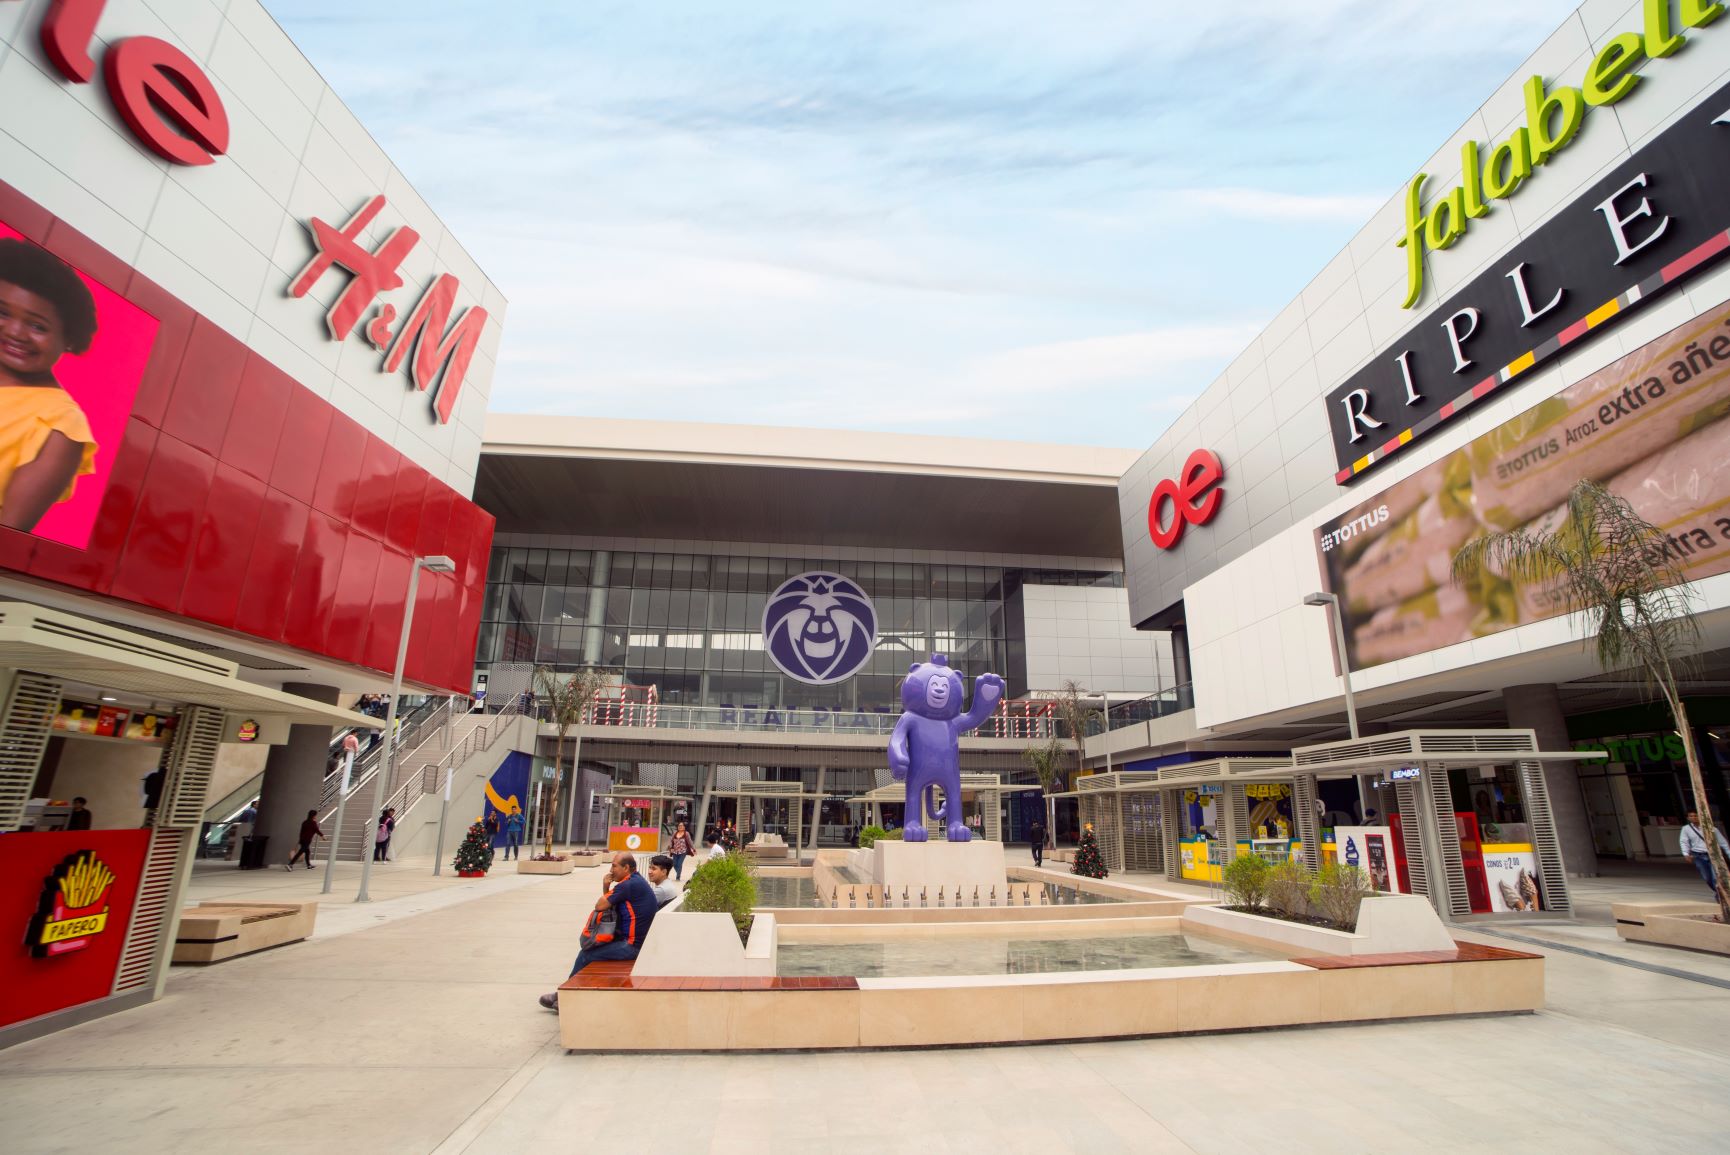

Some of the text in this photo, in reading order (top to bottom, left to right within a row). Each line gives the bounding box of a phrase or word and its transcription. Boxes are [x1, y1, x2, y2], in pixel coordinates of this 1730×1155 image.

[287, 194, 488, 427] H&M
[1340, 109, 1730, 444] RIPLE
[1505, 318, 1730, 476] TOTTUS Arroz extra añe
[1147, 448, 1225, 551] oe
[1331, 504, 1390, 545] TOTTUS
[720, 703, 905, 729] REAL PLAZ
[1392, 768, 1420, 779] BEMBOS
[49, 918, 98, 940] PAPERO
